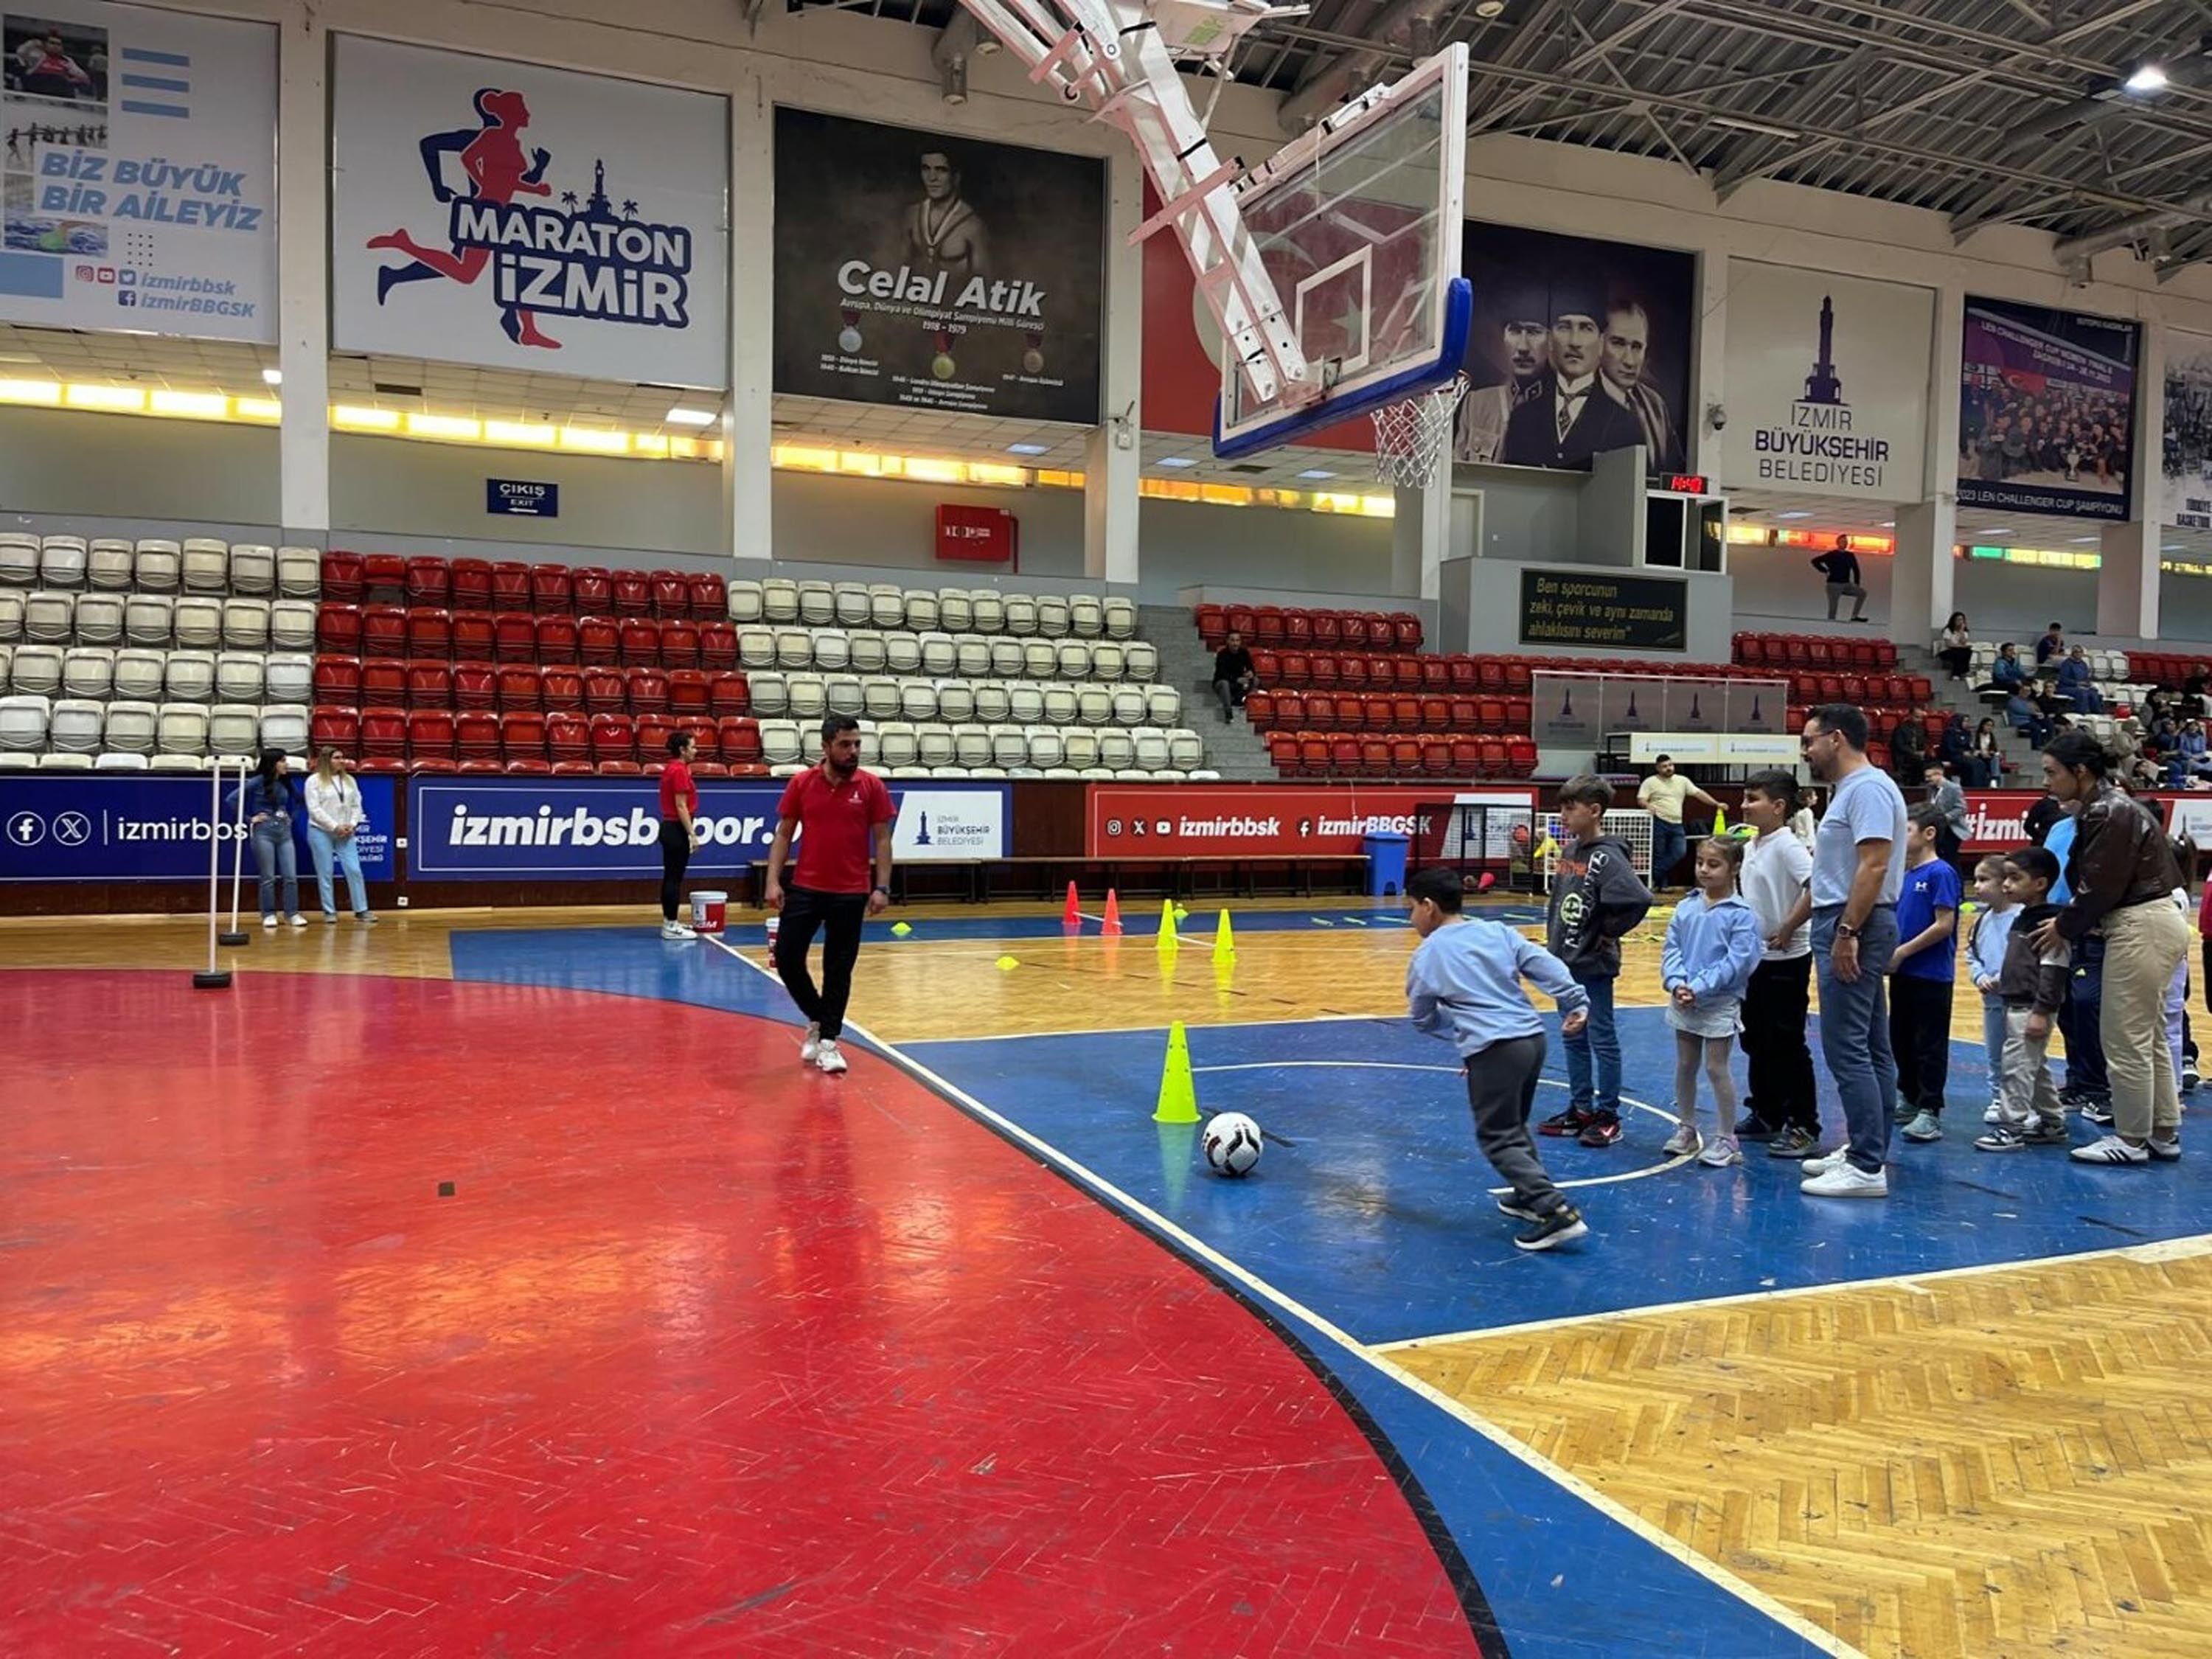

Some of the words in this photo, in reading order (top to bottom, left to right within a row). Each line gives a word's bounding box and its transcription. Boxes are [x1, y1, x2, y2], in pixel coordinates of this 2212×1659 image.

[41, 150, 108, 181] BİZ
[113, 157, 246, 196] BÜYÜK
[41, 183, 107, 215] BİR
[113, 192, 262, 232] AİLEYİZ
[456, 204, 684, 268] MARATON
[139, 272, 236, 296] izmirbbsk
[838, 260, 949, 305] Celal
[956, 276, 1048, 316] Atik
[1755, 426, 1890, 462] BÜYÜKŞEHİR
[1759, 458, 1882, 487] BELEDİYESİ
[499, 483, 546, 498] ÇIKIŞ
[510, 498, 535, 507] EXIT
[1978, 491, 1995, 502] LEN
[1996, 492, 2055, 509] CHALLENGER
[2056, 498, 2076, 509] CUP
[1537, 577, 1559, 594] Ben
[1561, 582, 1618, 599] sporcunun
[1557, 602, 1586, 619] çevik
[1589, 607, 1601, 617] ve
[1630, 608, 1674, 622] zamanda
[118, 817, 254, 841] izmirbbs
[1179, 815, 1281, 836] izmirbbsk
[1318, 815, 1433, 835] izmirBBGSK
